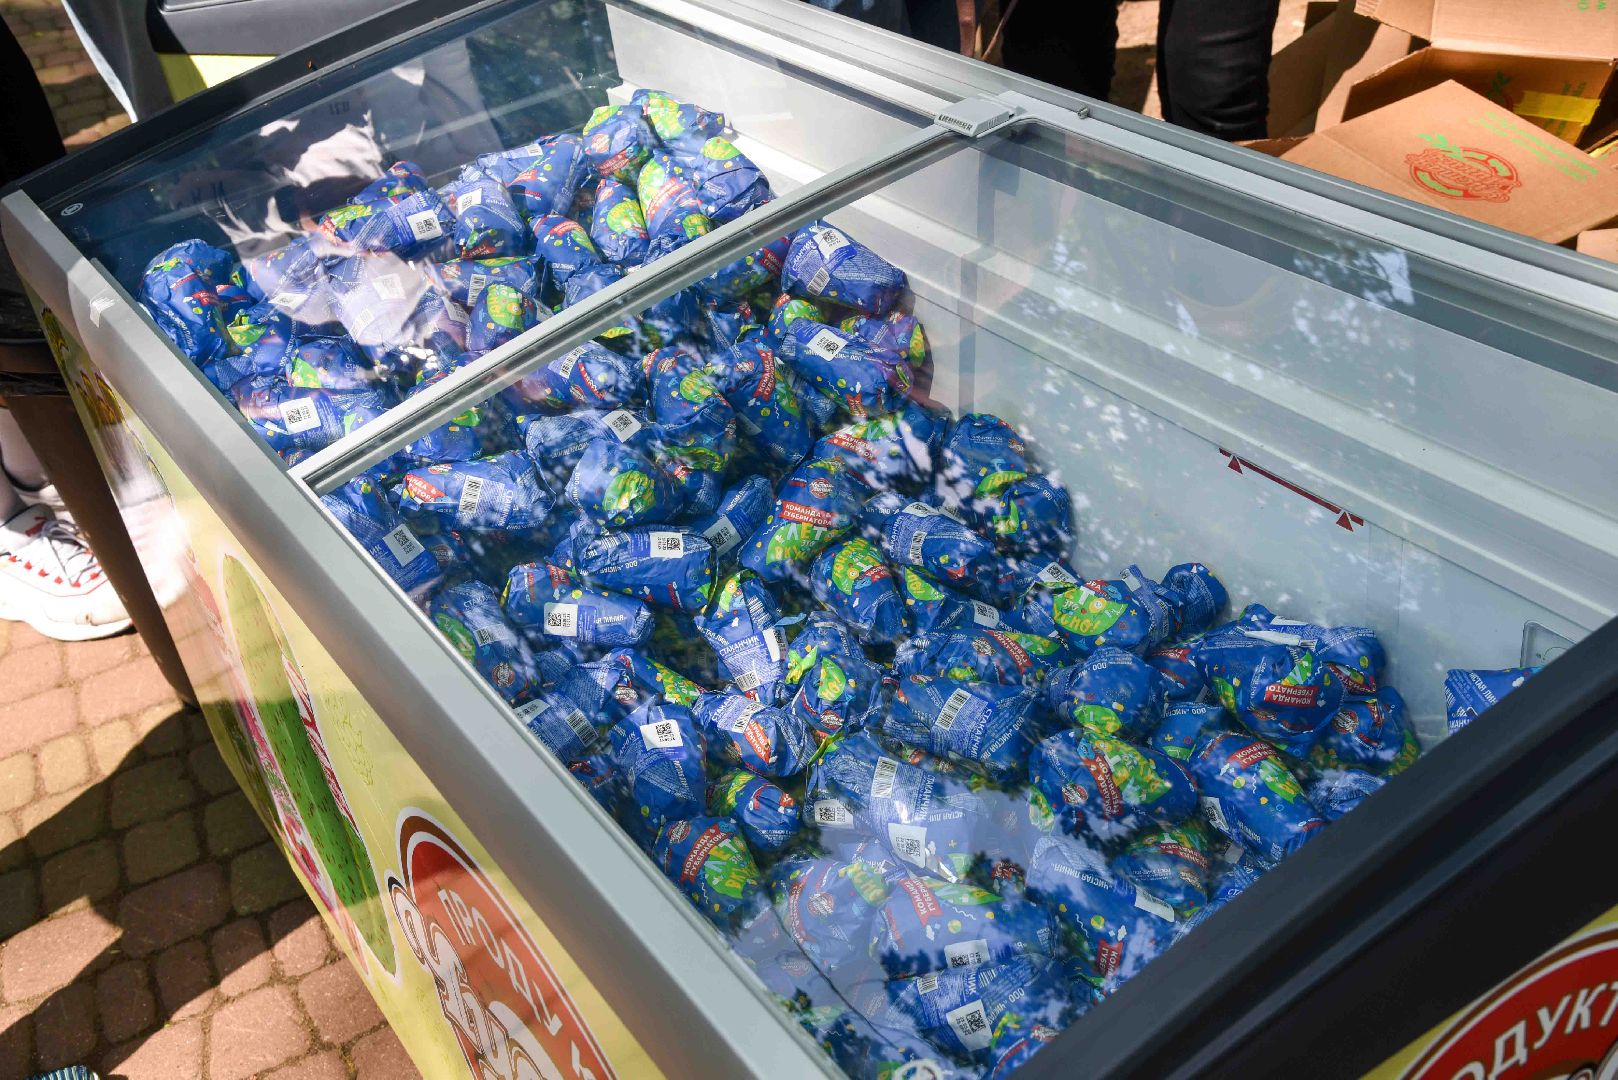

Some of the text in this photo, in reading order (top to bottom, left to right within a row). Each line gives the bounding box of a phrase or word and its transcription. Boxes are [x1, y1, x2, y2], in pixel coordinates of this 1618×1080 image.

[783, 510, 832, 526] ГУБЕРНАТОРА
[785, 503, 816, 518] КОМАНДА
[720, 635, 759, 657] СТАКАНЧИК
[1092, 662, 1107, 670] ООО
[1271, 694, 1311, 705] КОМАНДА
[1191, 708, 1207, 716] ООО
[1013, 716, 1024, 731] ООО
[970, 708, 992, 760] СТАКАНЧИК
[684, 834, 711, 874] КОМАНДА
[689, 832, 727, 876] ГУБЕРНАТОРА
[1009, 989, 1025, 1004] ООО
